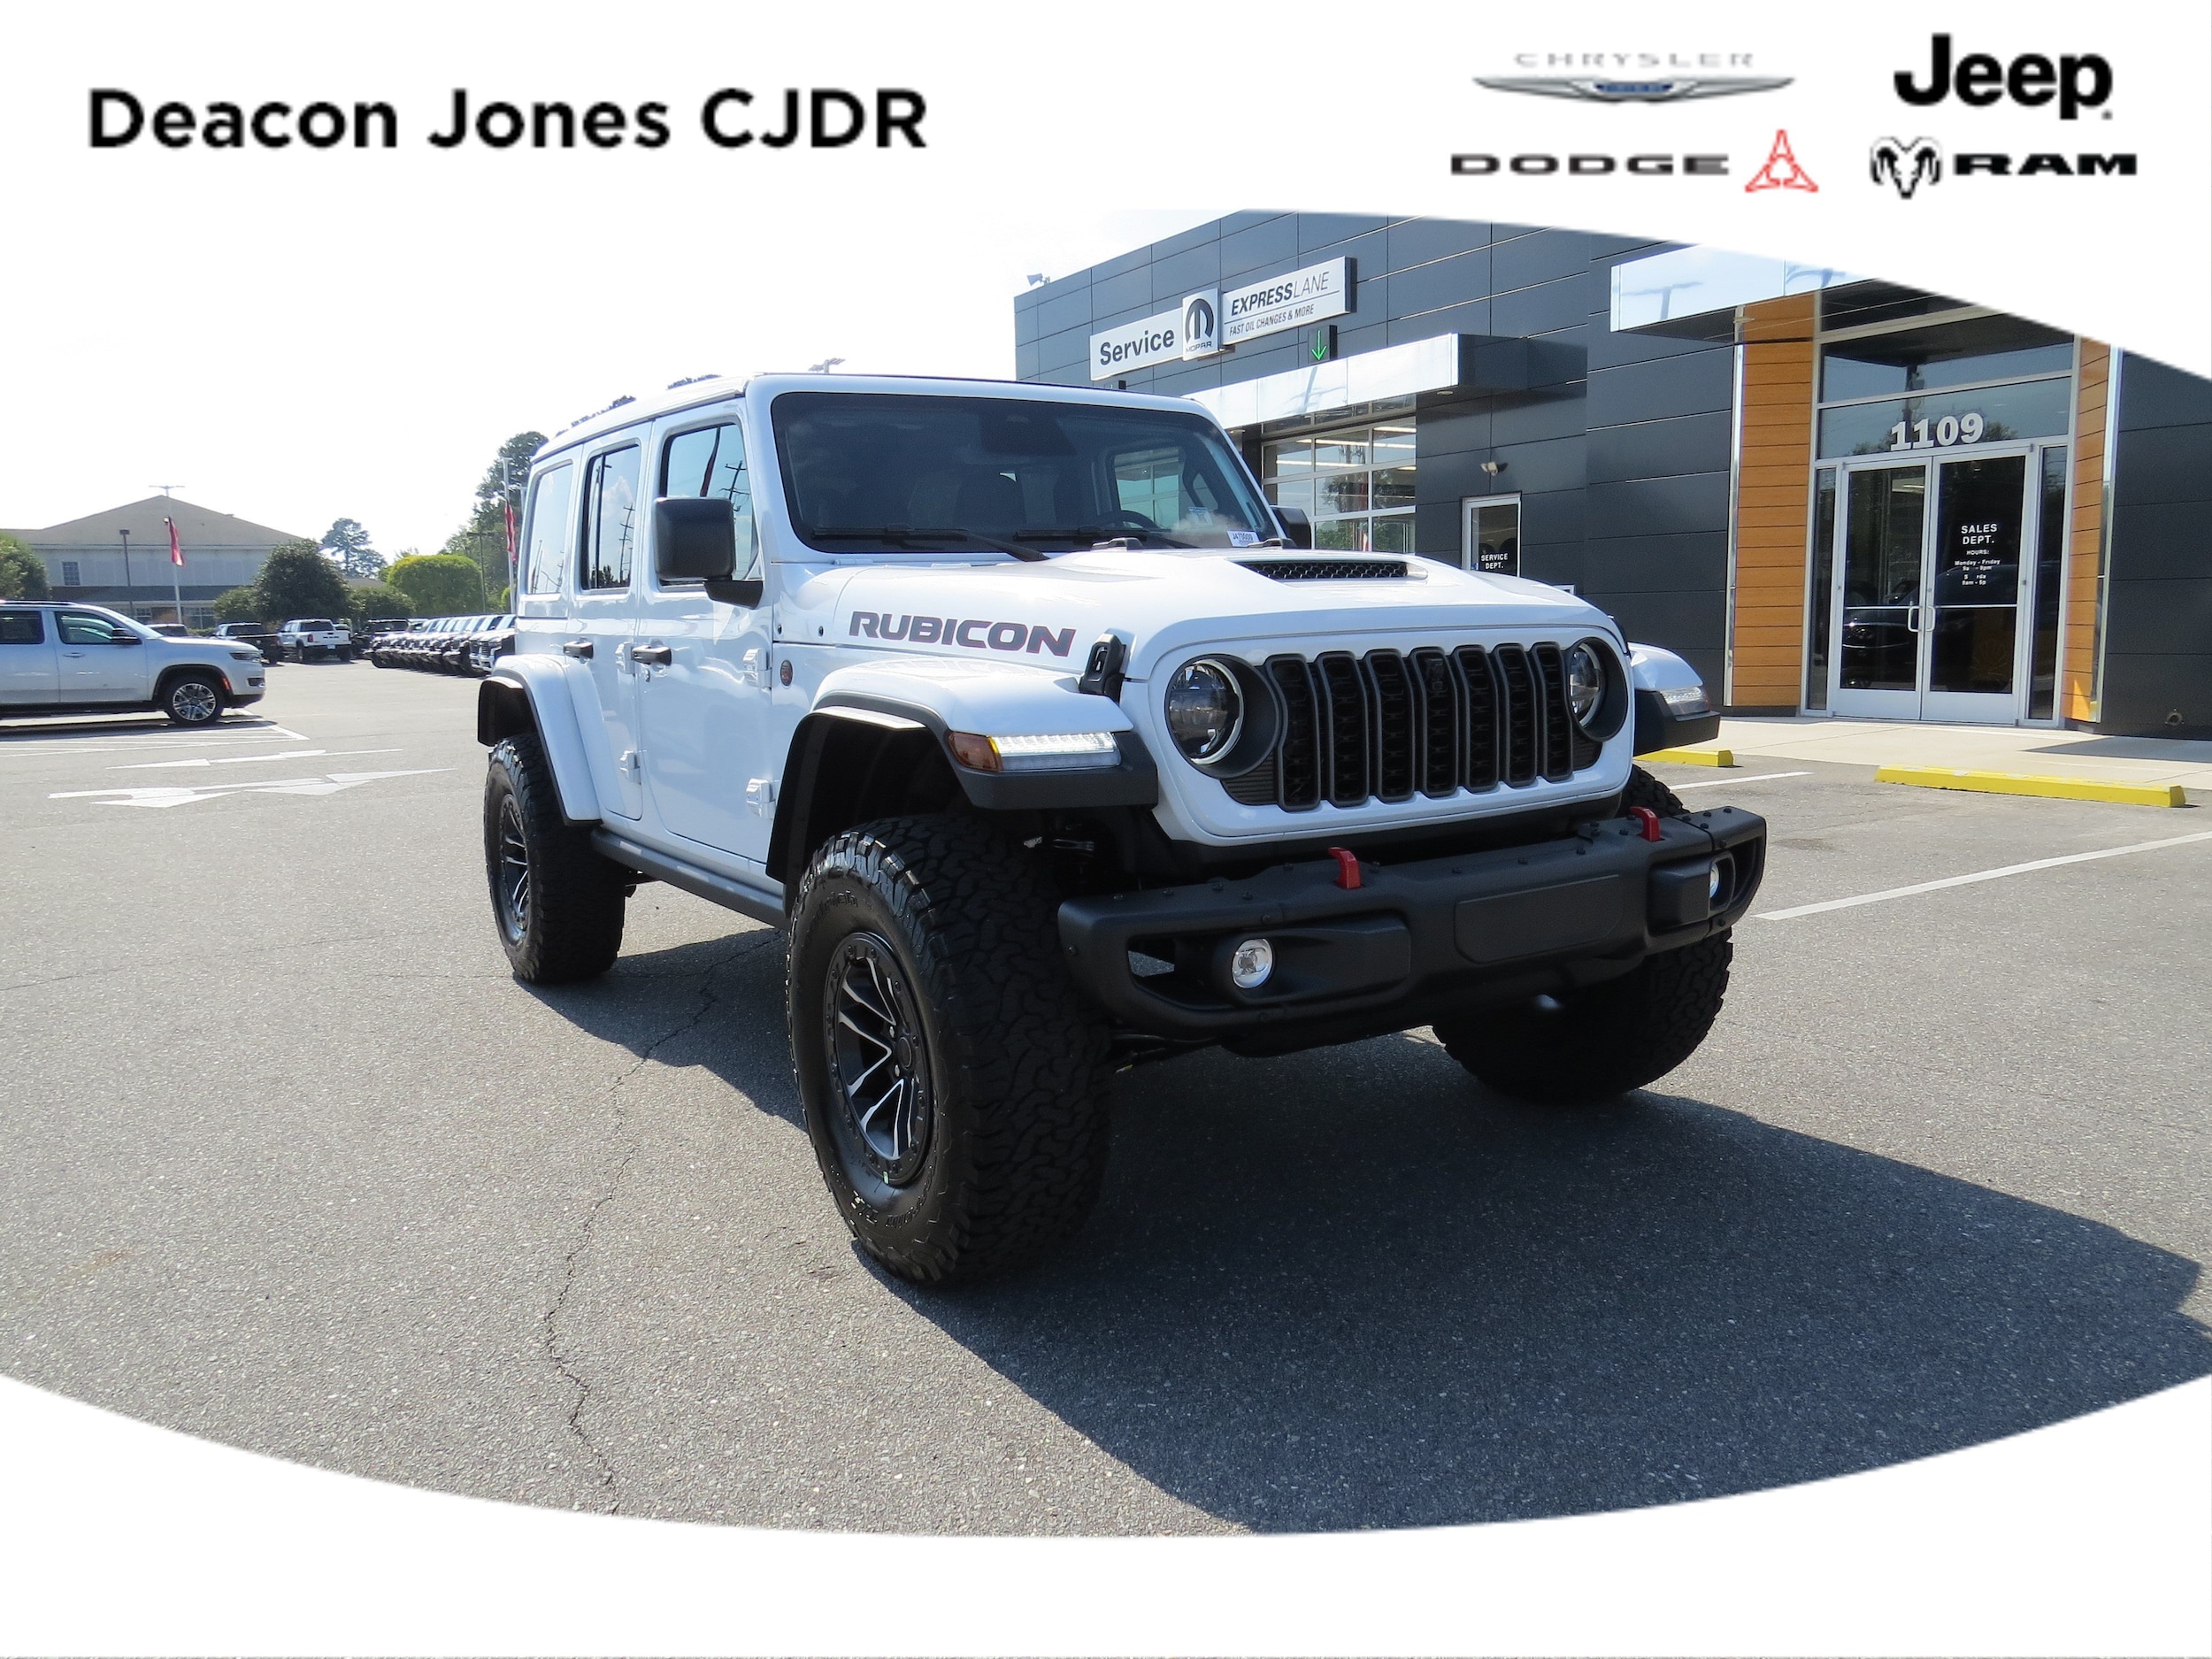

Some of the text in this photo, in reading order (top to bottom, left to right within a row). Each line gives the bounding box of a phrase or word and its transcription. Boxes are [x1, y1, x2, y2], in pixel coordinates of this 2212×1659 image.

[1229, 303, 1315, 336] FAST OIL CHANGES & MORE
[1100, 329, 1175, 365] Service
[1185, 341, 1212, 353] MOPAR
[1890, 412, 1985, 451] 1109
[1961, 524, 1998, 534] SALES
[1962, 535, 1995, 545] DEPT.
[1480, 553, 1509, 562] SERVICE
[849, 611, 1077, 657] RUBICON
